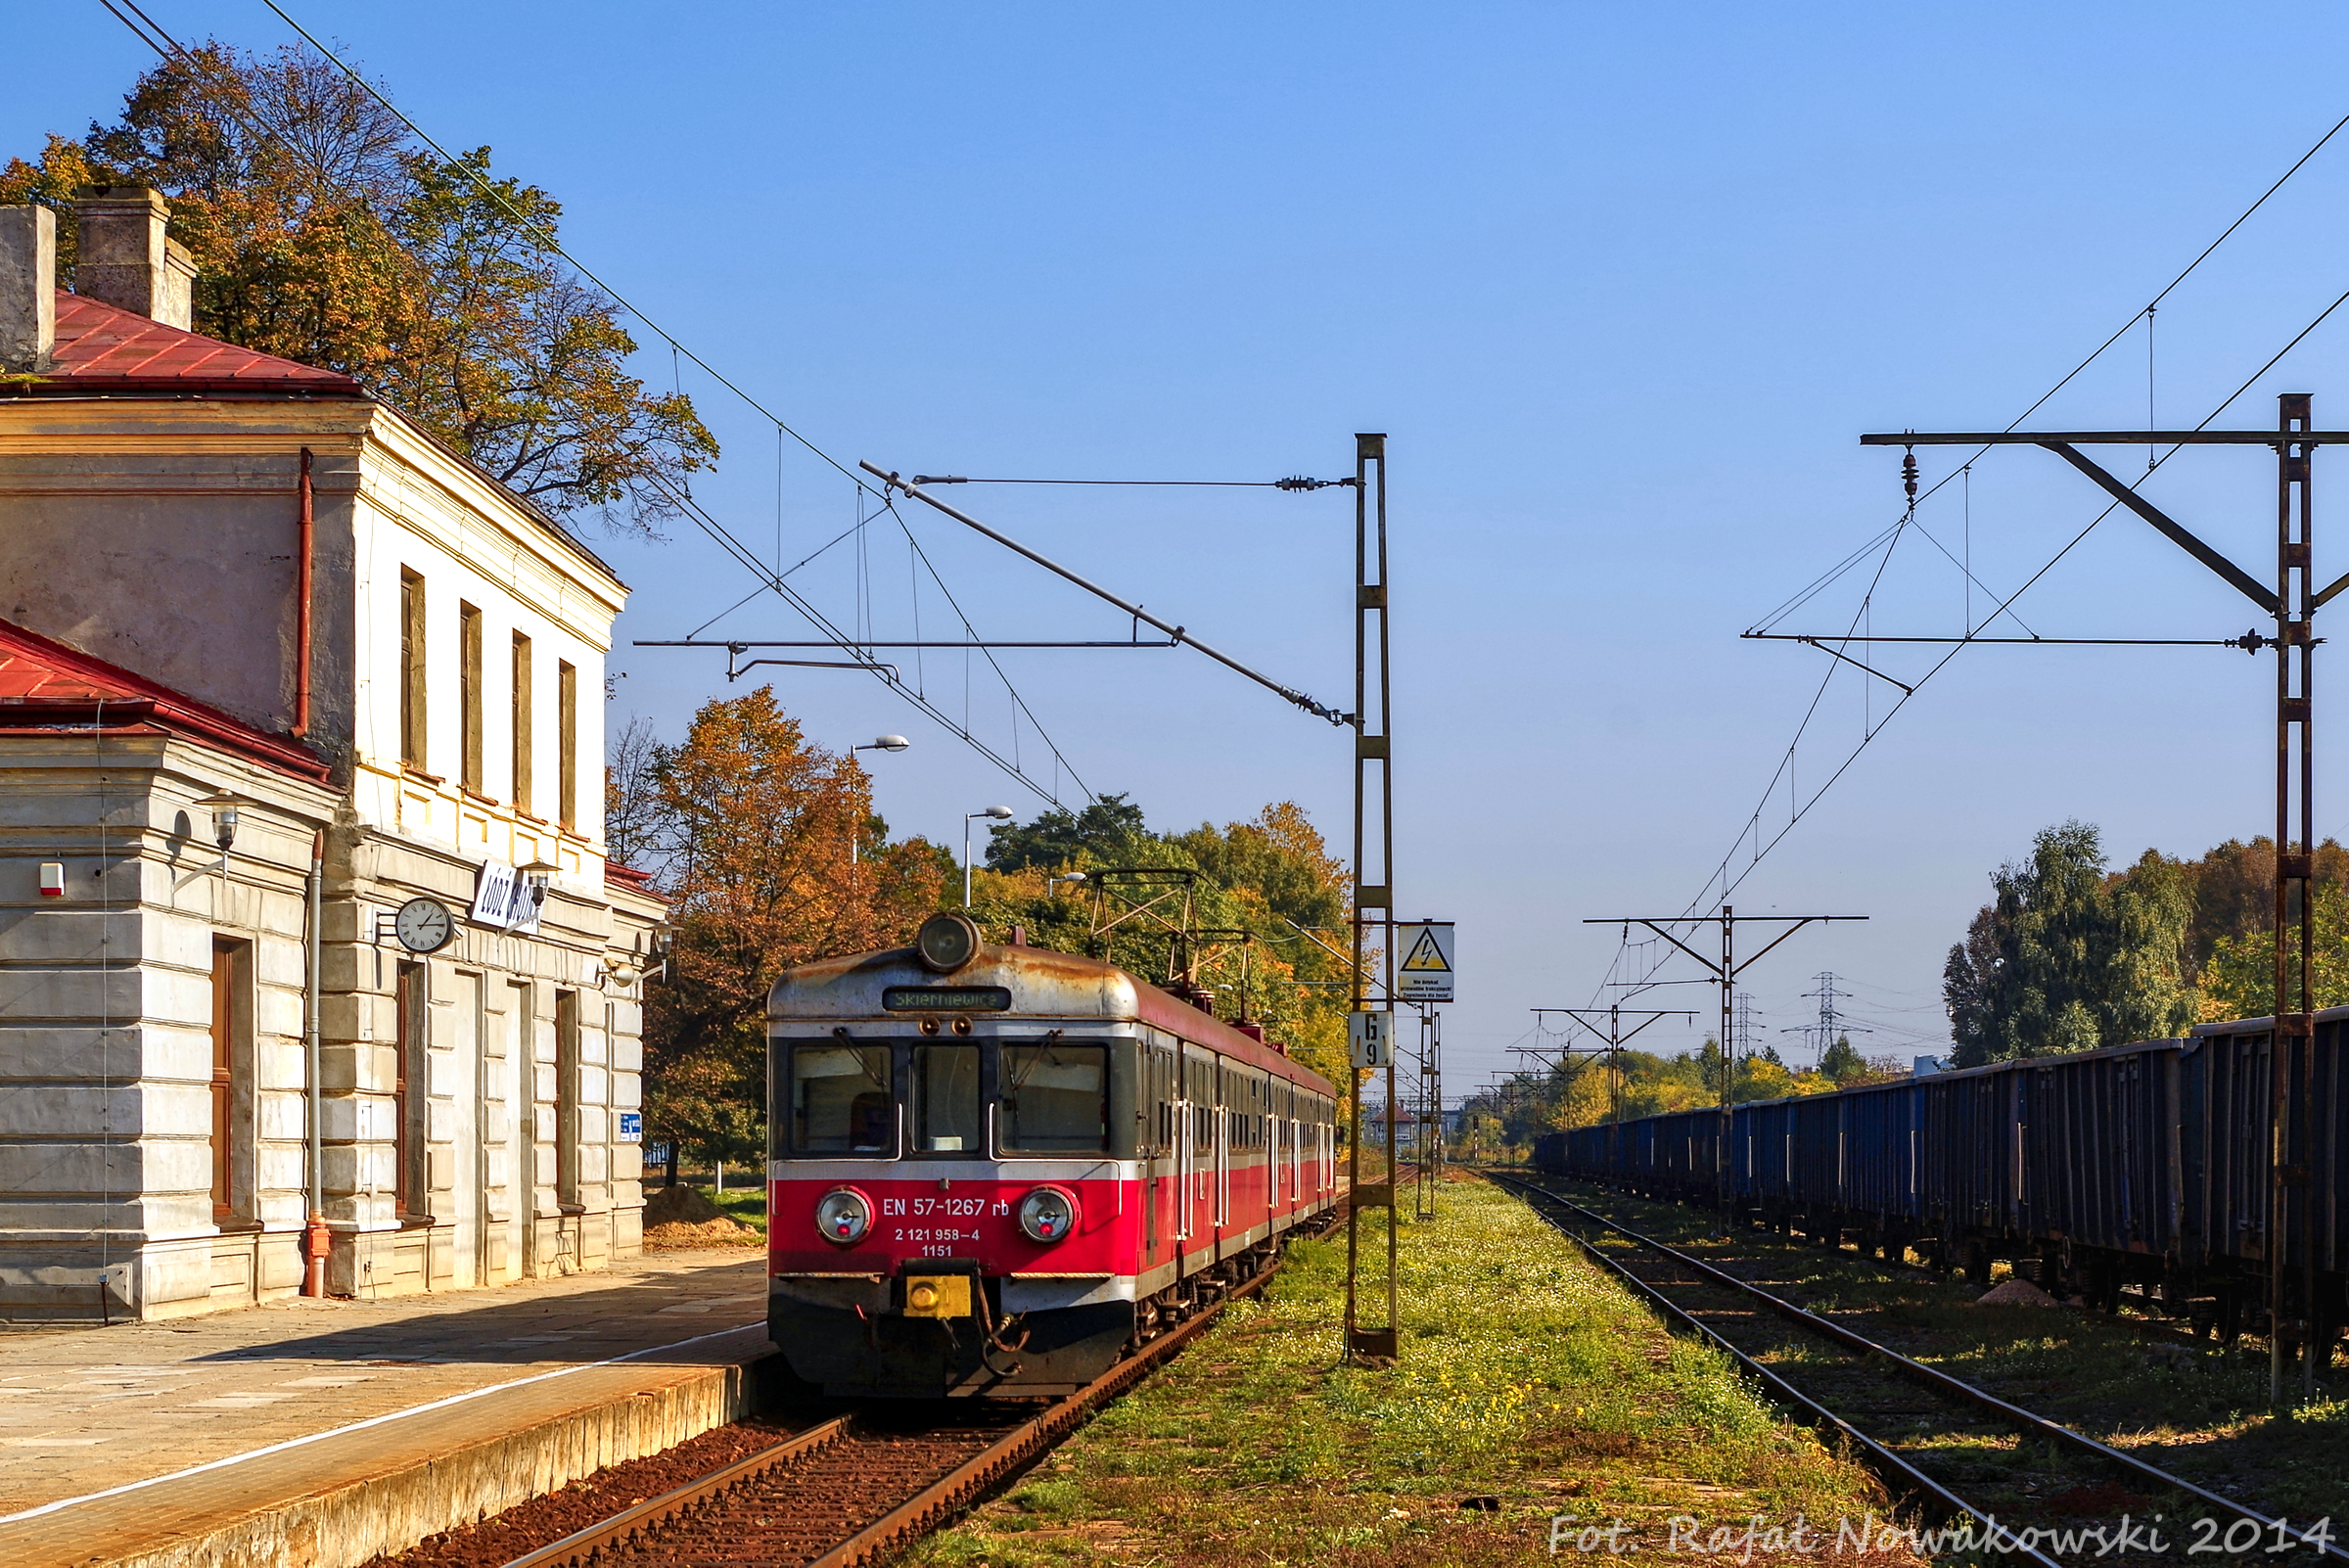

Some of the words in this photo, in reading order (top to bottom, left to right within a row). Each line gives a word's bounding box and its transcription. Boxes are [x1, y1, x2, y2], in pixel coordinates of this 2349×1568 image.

[895, 992, 997, 1006] Skierniewice
[1366, 1043, 1377, 1065] 9
[883, 1198, 905, 1216] EN
[913, 1198, 986, 1216] 57-1267
[992, 1199, 1009, 1216] rb
[895, 1228, 903, 1240] 2
[907, 1228, 930, 1240] 121
[922, 1245, 951, 1257] 1151
